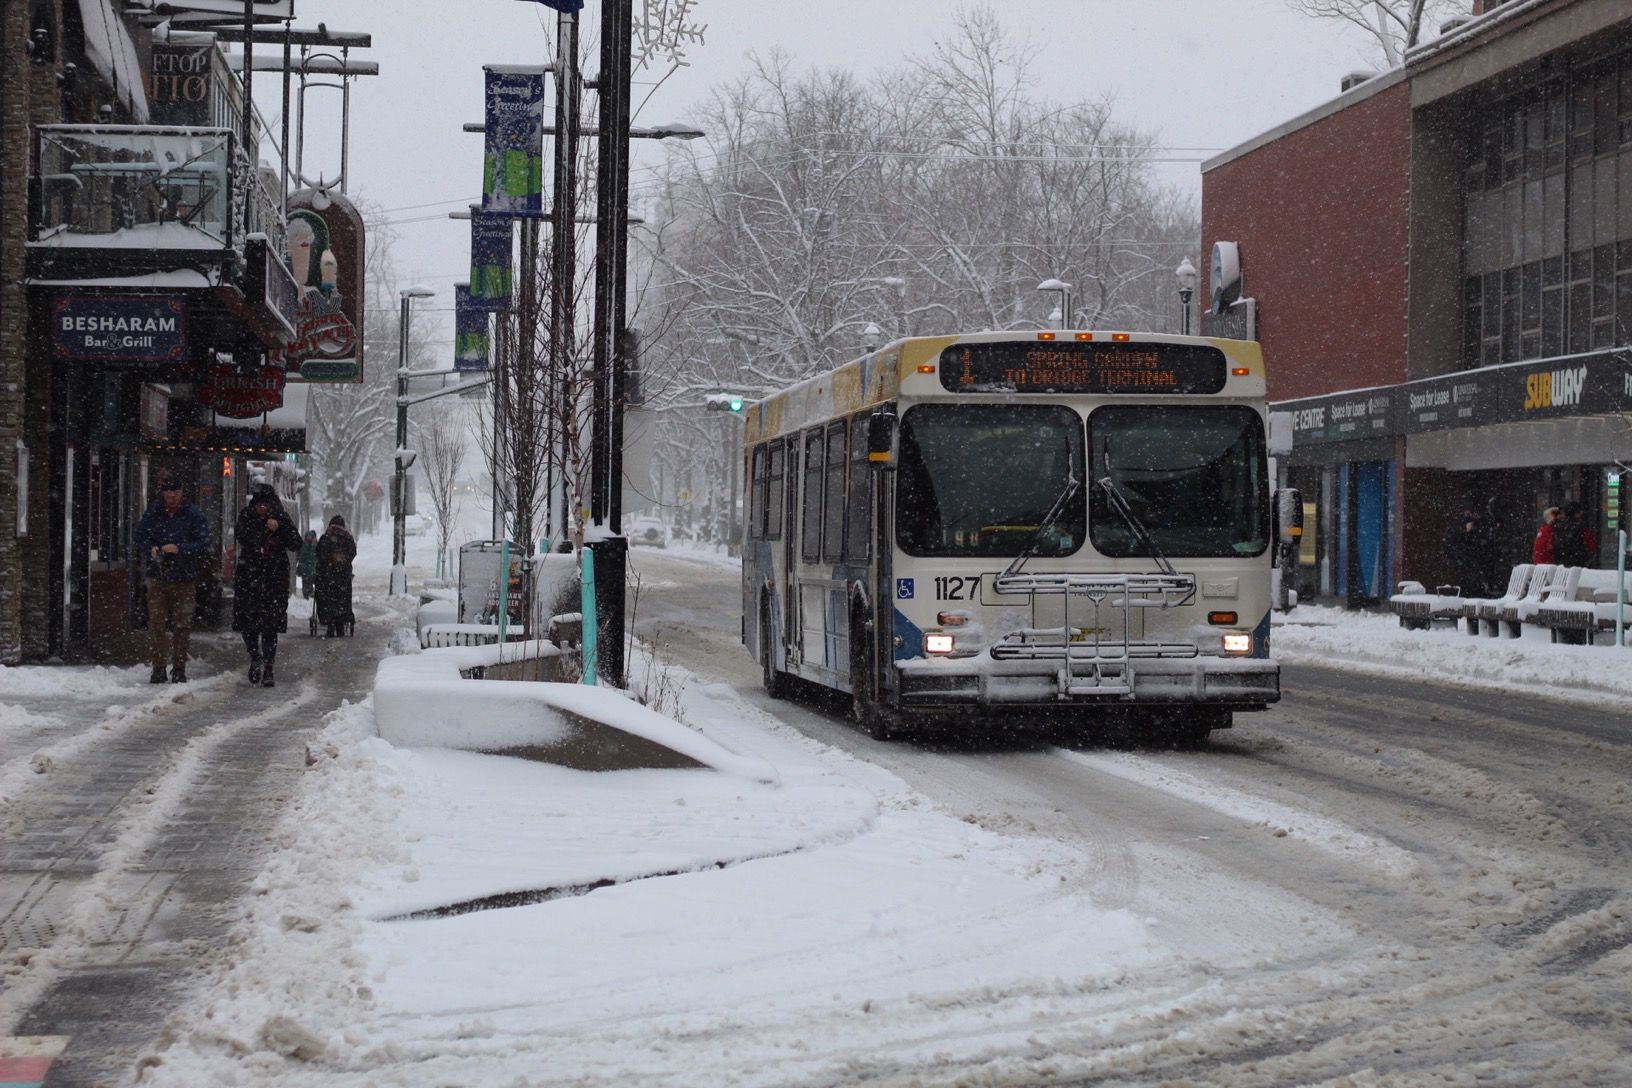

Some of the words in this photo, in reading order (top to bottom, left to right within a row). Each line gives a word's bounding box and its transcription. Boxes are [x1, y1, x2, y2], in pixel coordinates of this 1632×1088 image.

[487, 97, 536, 115] Greetin
[62, 316, 175, 332] BESHARAM
[1026, 351, 1088, 369] SPRING
[1094, 351, 1159, 369] GARDEN
[1005, 369, 1027, 384] TO
[1032, 369, 1090, 385] BRIDGE
[1097, 369, 1178, 385] TERMINAL
[1523, 363, 1588, 412] SUBWAY
[1331, 404, 1345, 422] Space
[1345, 401, 1353, 418] for
[1352, 401, 1366, 417] Lease
[1410, 392, 1425, 413] Space
[1425, 389, 1434, 408] for
[1434, 389, 1450, 406] Lease
[1300, 407, 1325, 431] CENTRE
[934, 576, 980, 601] 1127
